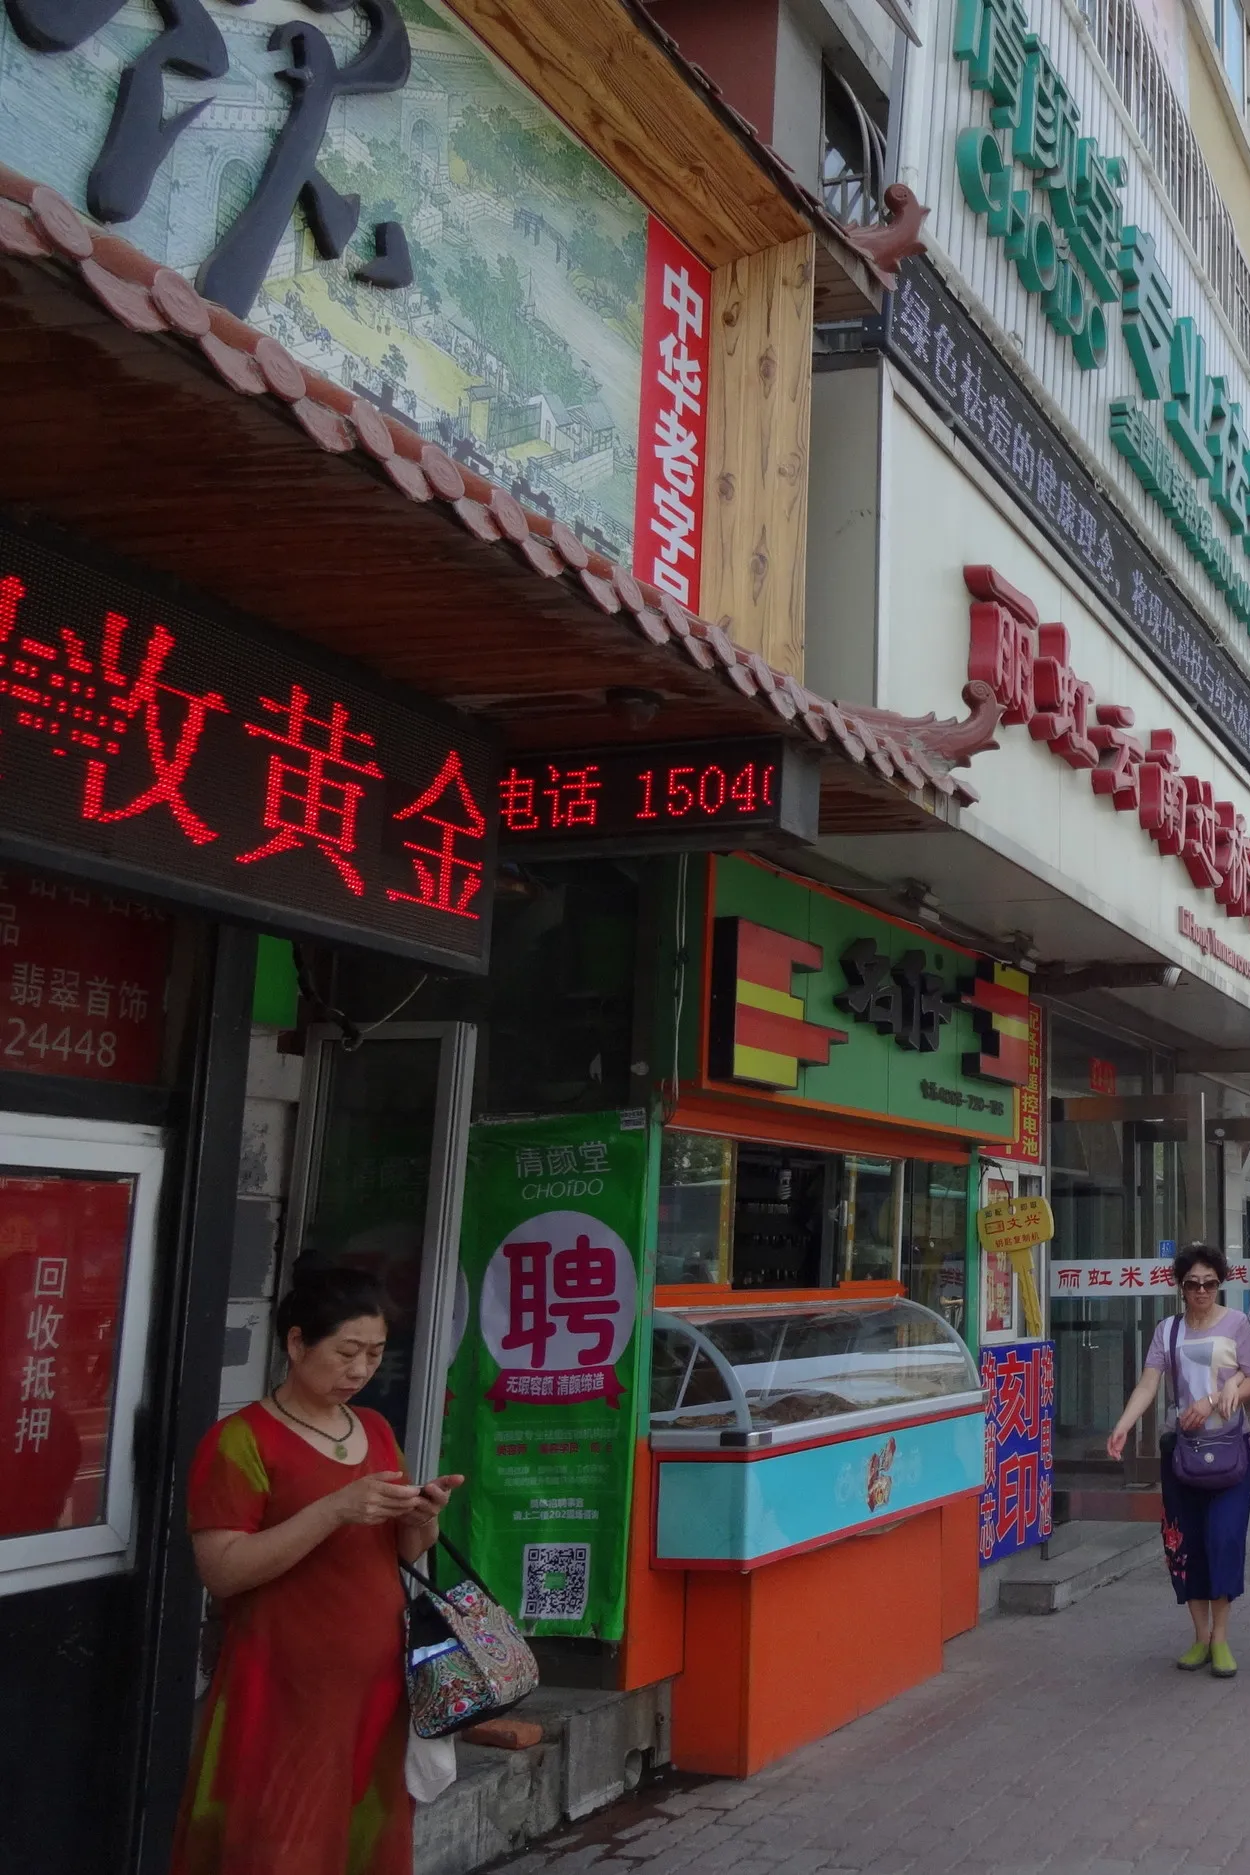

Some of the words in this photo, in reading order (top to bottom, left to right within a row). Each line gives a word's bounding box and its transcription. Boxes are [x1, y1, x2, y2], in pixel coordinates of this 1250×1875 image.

[499, 765, 601, 831] 电话
[10, 962, 149, 1024] 翡翠首饰
[514, 1140, 612, 1179] 清颜堂
[994, 1231, 1040, 1250] 钥匙复制机
[1005, 1213, 1041, 1232] 文兴
[501, 1234, 621, 1369] 聘
[1057, 1264, 1177, 1290] 丽虹米线
[14, 1256, 68, 1455] 回收抵押
[505, 1374, 554, 1397] 无瑕容颜
[556, 1371, 605, 1396] 清颜缔造
[996, 1348, 1041, 1546] 刻印
[1037, 1344, 1055, 1538] 换电池
